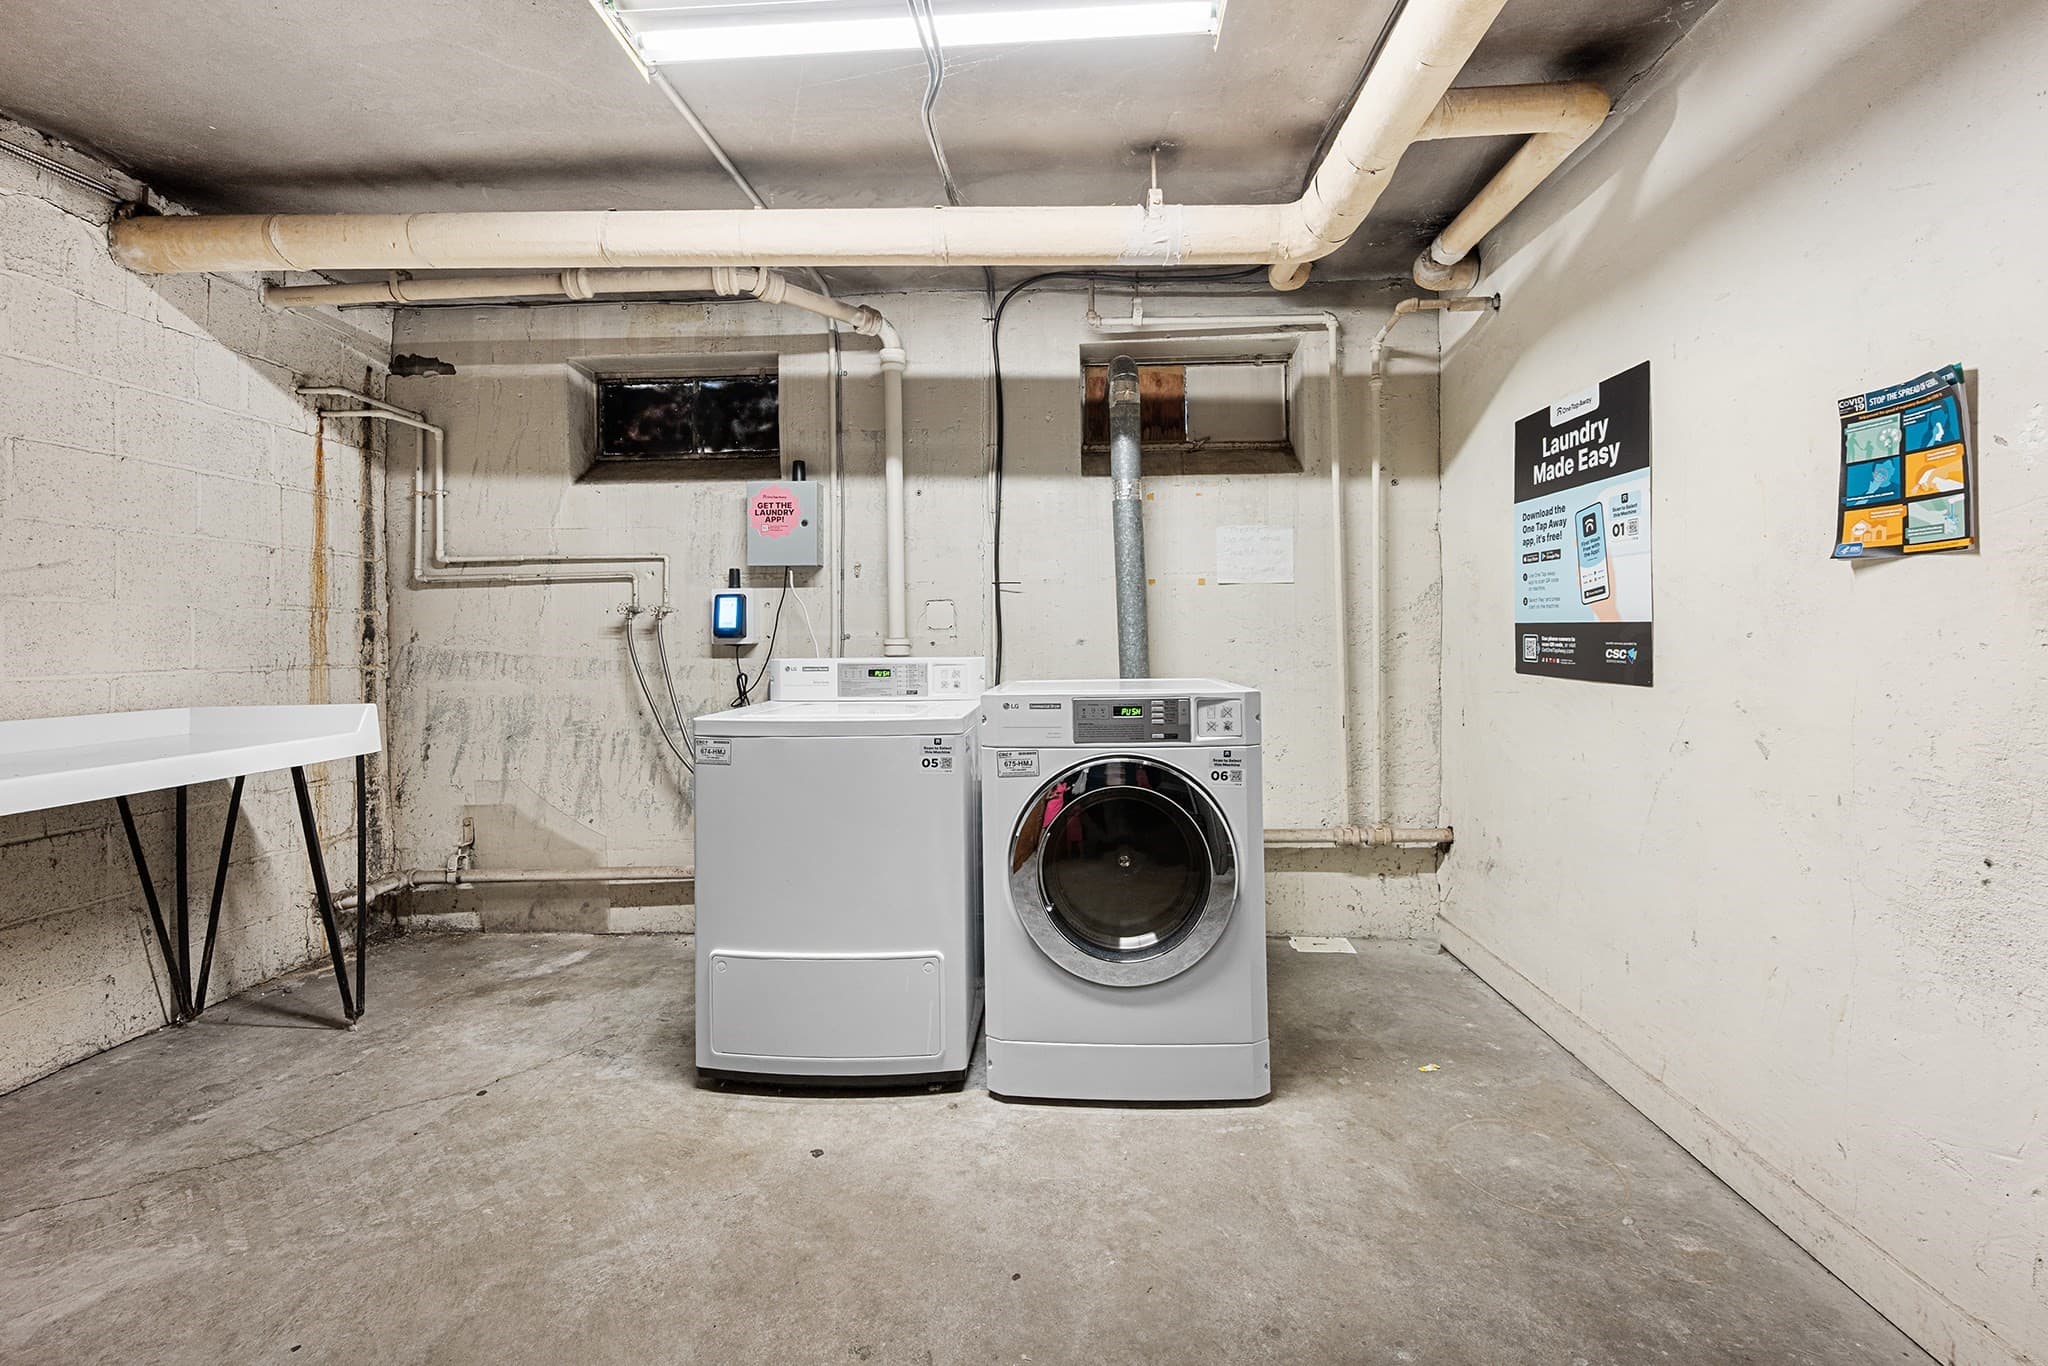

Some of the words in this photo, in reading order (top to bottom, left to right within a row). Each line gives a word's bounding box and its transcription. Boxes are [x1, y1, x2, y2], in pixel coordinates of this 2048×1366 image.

[1869, 394, 1886, 406] STOP
[1886, 392, 1898, 402] THE
[1854, 403, 1864, 412] 19
[1542, 417, 1609, 458] Laundry
[1533, 456, 1574, 486] Made
[1578, 441, 1620, 472] Easy
[1522, 506, 1553, 522] Download
[1555, 505, 1566, 514] the
[1523, 525, 1534, 534] One
[1536, 522, 1547, 532] Tap
[1548, 518, 1567, 528] Away
[1612, 522, 1624, 537] 01
[1523, 538, 1535, 547] app,
[1536, 534, 1545, 543] it's
[1547, 531, 1562, 541] free!
[1605, 648, 1627, 659] CSC
[922, 758, 938, 768] 05
[1211, 770, 1228, 781] 06
